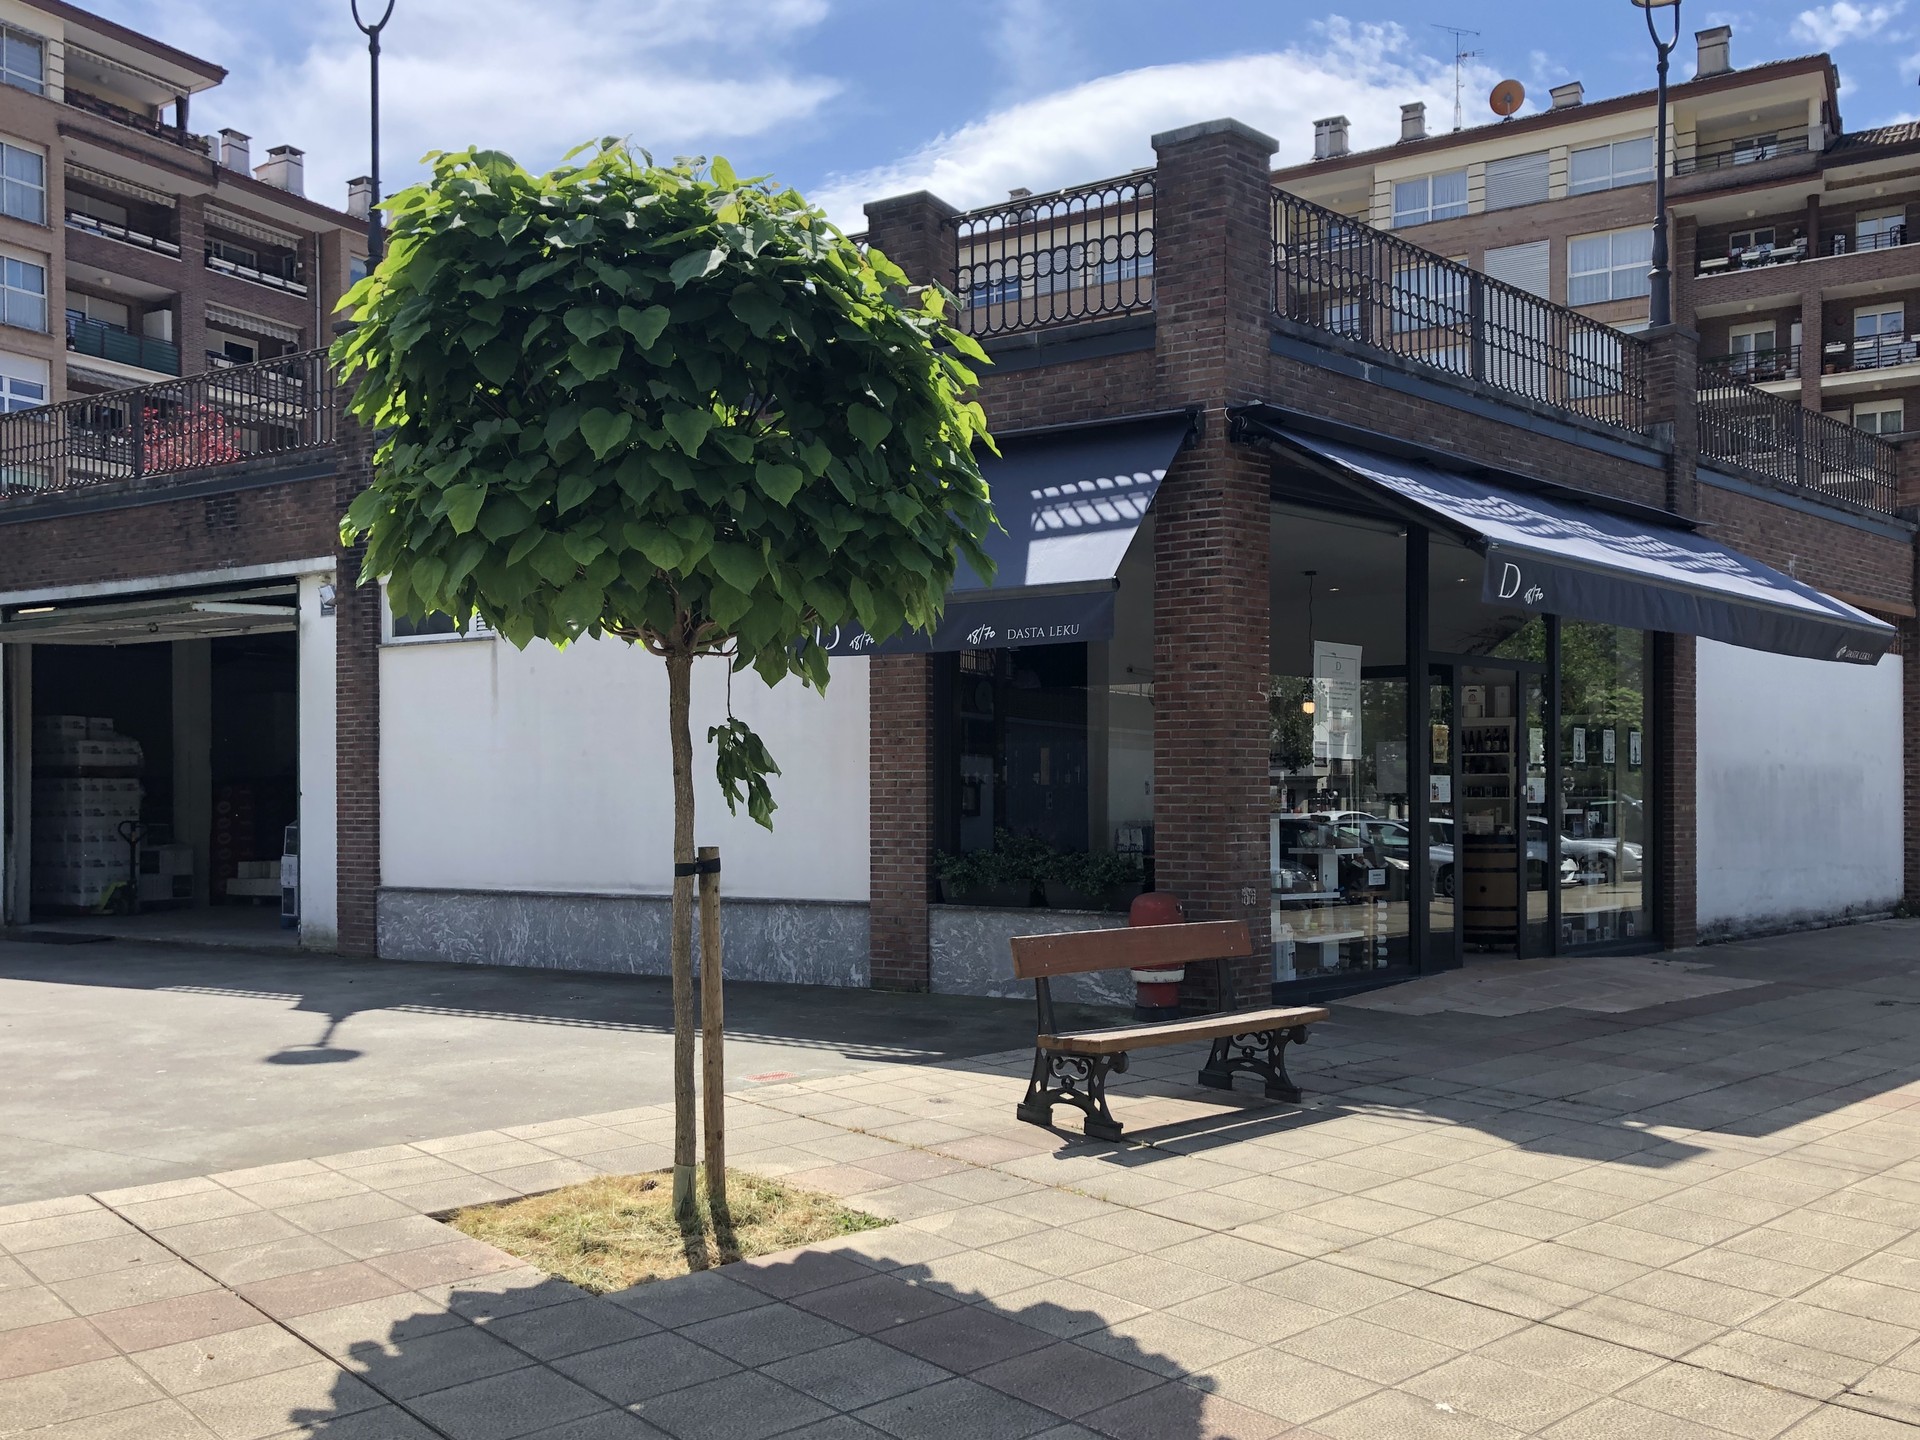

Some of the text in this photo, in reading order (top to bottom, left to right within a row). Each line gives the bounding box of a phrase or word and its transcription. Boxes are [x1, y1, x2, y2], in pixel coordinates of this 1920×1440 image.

[1498, 562, 1522, 599] D
[966, 623, 1080, 645] 18/70 DASTA LEKU
